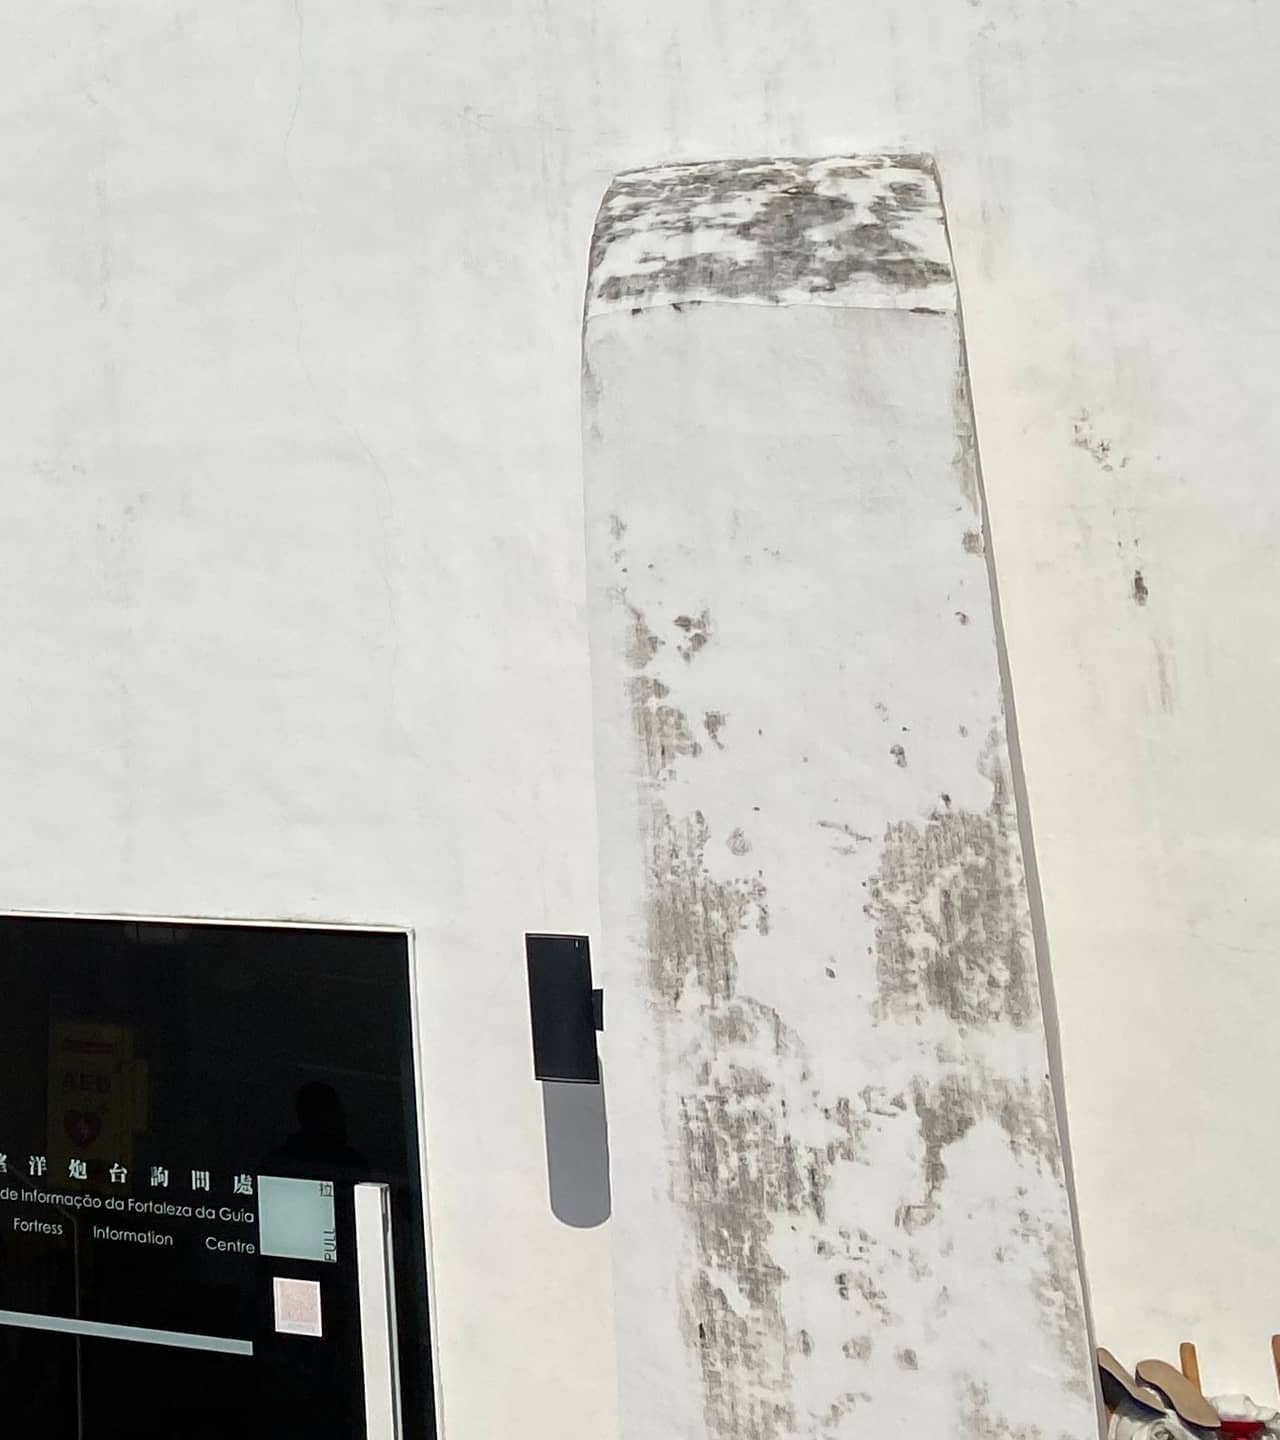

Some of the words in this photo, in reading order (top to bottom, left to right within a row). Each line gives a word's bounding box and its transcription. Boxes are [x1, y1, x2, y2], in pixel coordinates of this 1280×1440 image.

[0, 1187, 18, 1200] de
[21, 1188, 102, 1209] Informação
[104, 1197, 125, 1211] da
[128, 1198, 192, 1217] Fortaleza
[195, 1205, 216, 1219] da
[218, 1207, 254, 1223] Guia
[13, 1217, 63, 1235] Fortress
[93, 1225, 174, 1246] Information
[205, 1236, 256, 1254] Centre
[323, 1227, 337, 1262] PULL
